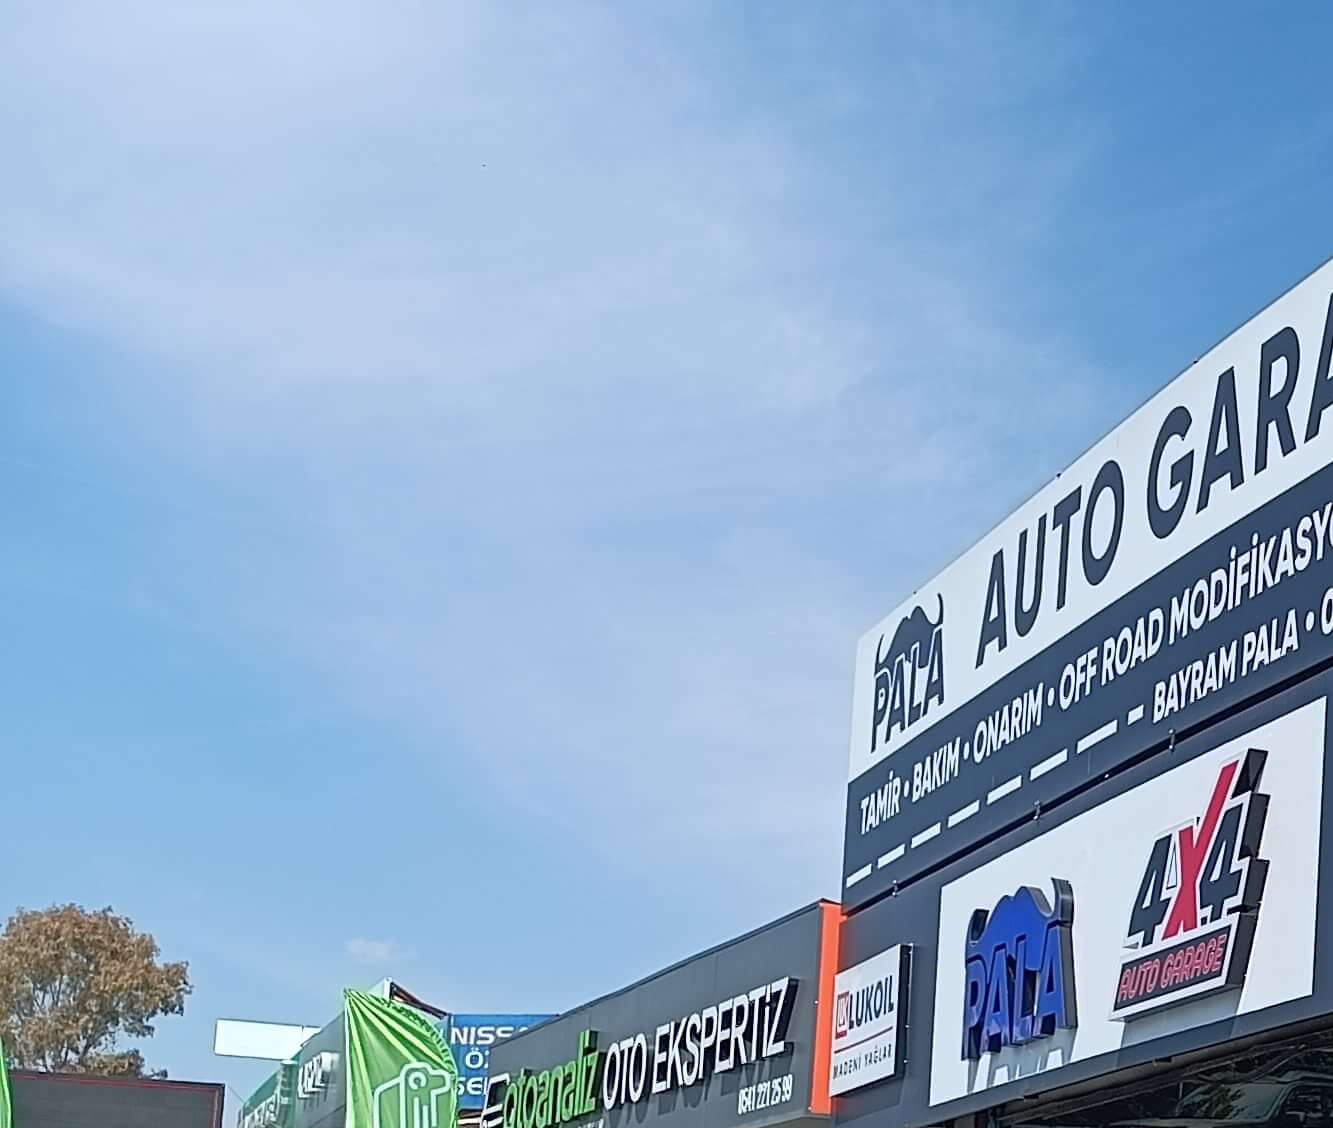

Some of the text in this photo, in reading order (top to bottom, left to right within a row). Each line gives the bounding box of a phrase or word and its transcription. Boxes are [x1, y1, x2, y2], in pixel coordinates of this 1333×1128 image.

[871, 623, 945, 754] PALA
[975, 459, 1124, 670] AUTO
[860, 770, 901, 835] TAMİR
[912, 736, 961, 803] BAKIM
[973, 682, 1044, 764] ONARIM
[1059, 647, 1099, 710] OFF
[1101, 608, 1164, 686] ROAD
[1153, 640, 1236, 724] BAYRAM
[1241, 608, 1299, 678] PALA
[848, 975, 895, 1031] LUKOIL
[962, 925, 1066, 1061] PALA
[1120, 934, 1227, 1001] AUTO GARAGE
[603, 1033, 648, 1112] OTO
